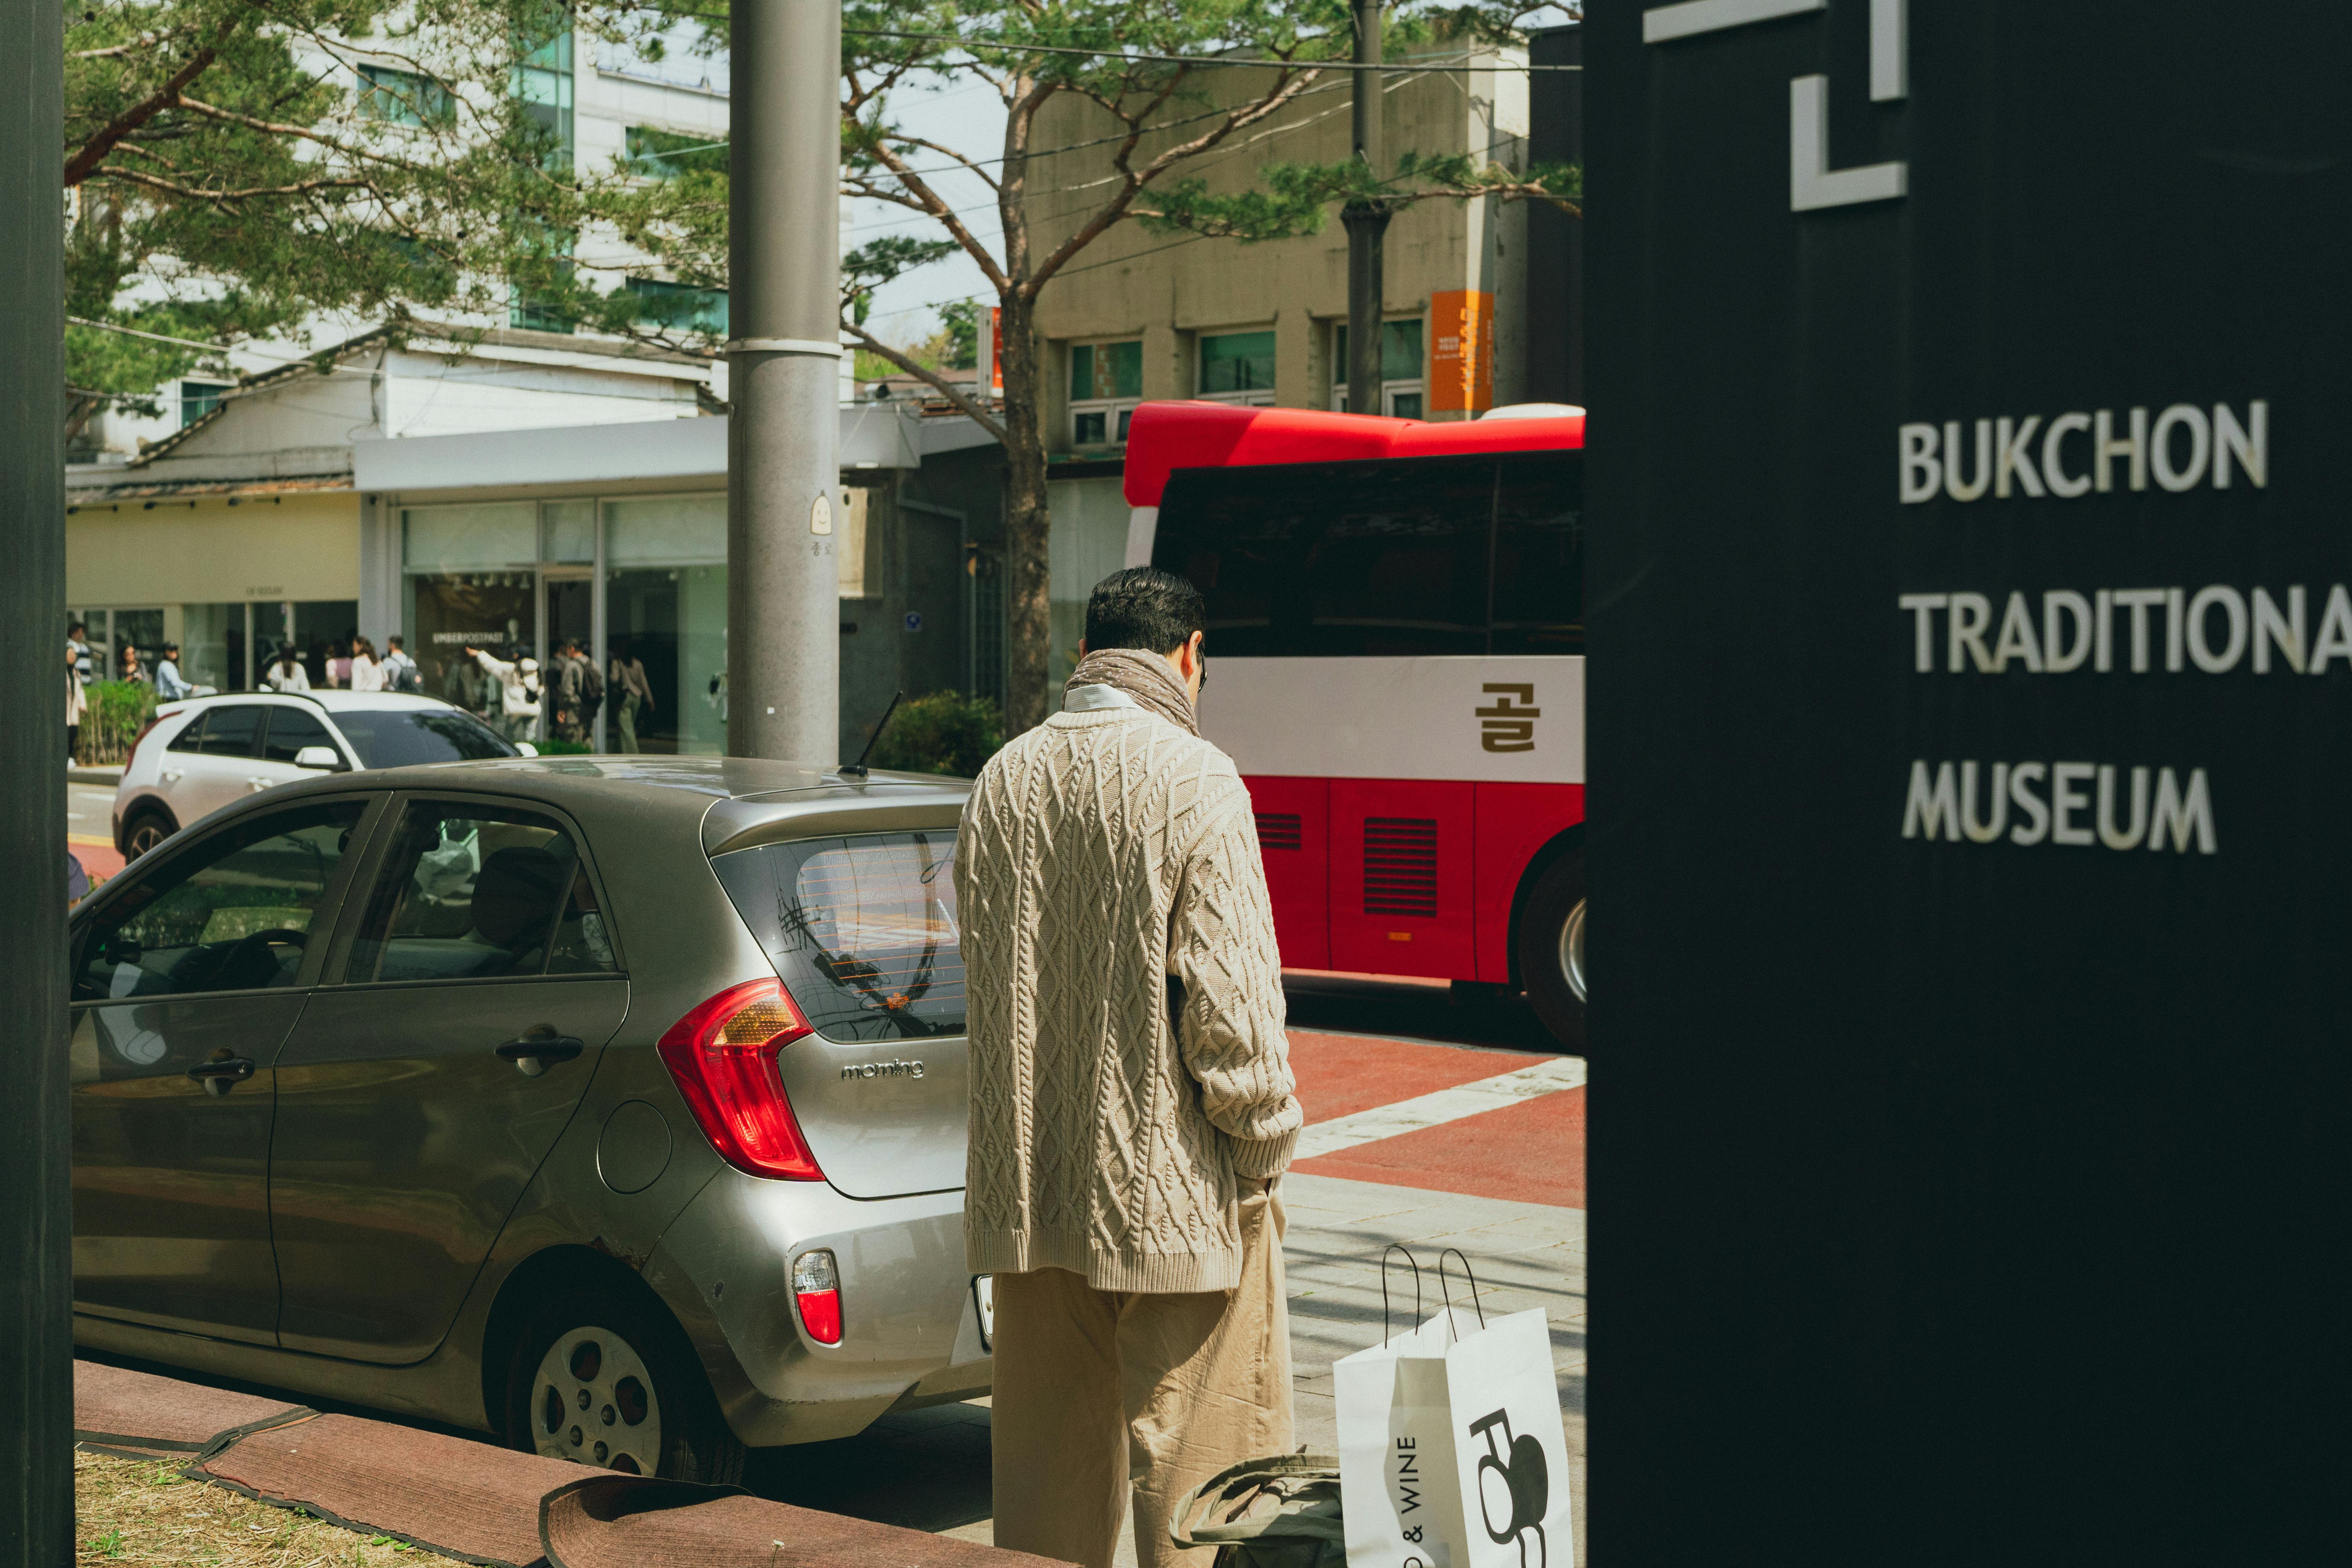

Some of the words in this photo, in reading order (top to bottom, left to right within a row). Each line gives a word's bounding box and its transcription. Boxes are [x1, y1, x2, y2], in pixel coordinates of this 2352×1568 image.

[1898, 399, 2268, 504] BUKCHON
[1898, 583, 2352, 675] TRADITIONA
[1475, 683, 1540, 753] 골
[1901, 760, 2218, 855] MUSEUM
[841, 1058, 924, 1079] morning
[1396, 1437, 1421, 1514] WINE
[1403, 1524, 1423, 1543] &
